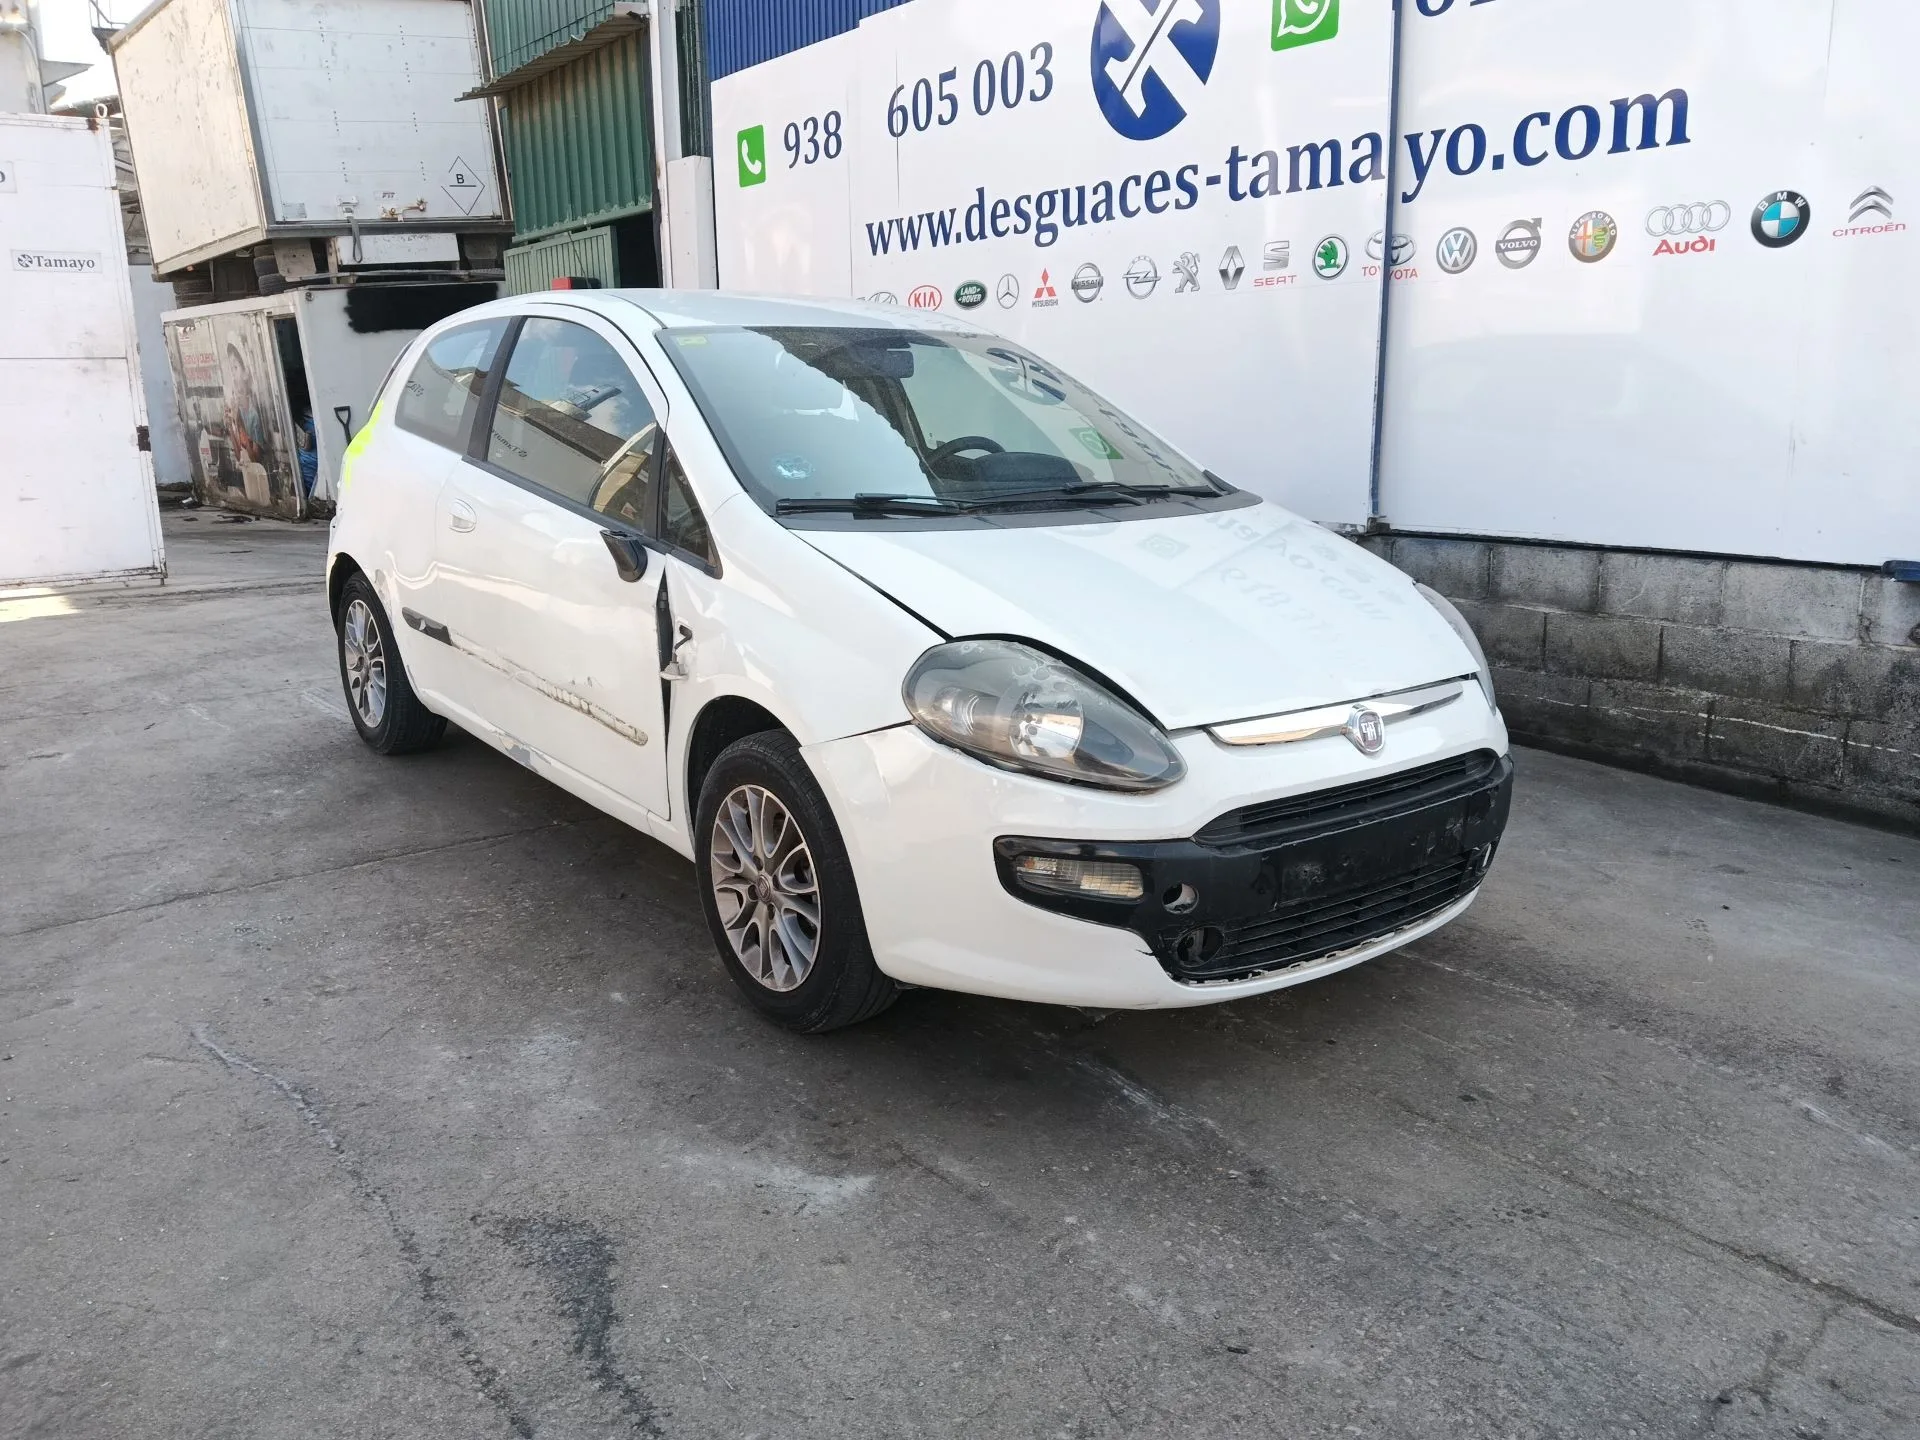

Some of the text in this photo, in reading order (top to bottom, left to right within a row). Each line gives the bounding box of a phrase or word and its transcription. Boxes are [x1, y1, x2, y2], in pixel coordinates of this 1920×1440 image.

[783, 41, 1054, 169] 938 605 003
[456, 173, 465, 184] B
[866, 88, 1692, 256] www.desguaces-tamayo.com
[1758, 191, 1807, 212] BMW
[1499, 239, 1538, 250] VOLVO
[33, 255, 95, 272] Tamayo
[1253, 275, 1297, 288] SEAT
[960, 286, 977, 295] LAND
[913, 291, 937, 308] KIA
[961, 294, 982, 303] ROVER
[1031, 300, 1059, 309] MITSUBISHI
